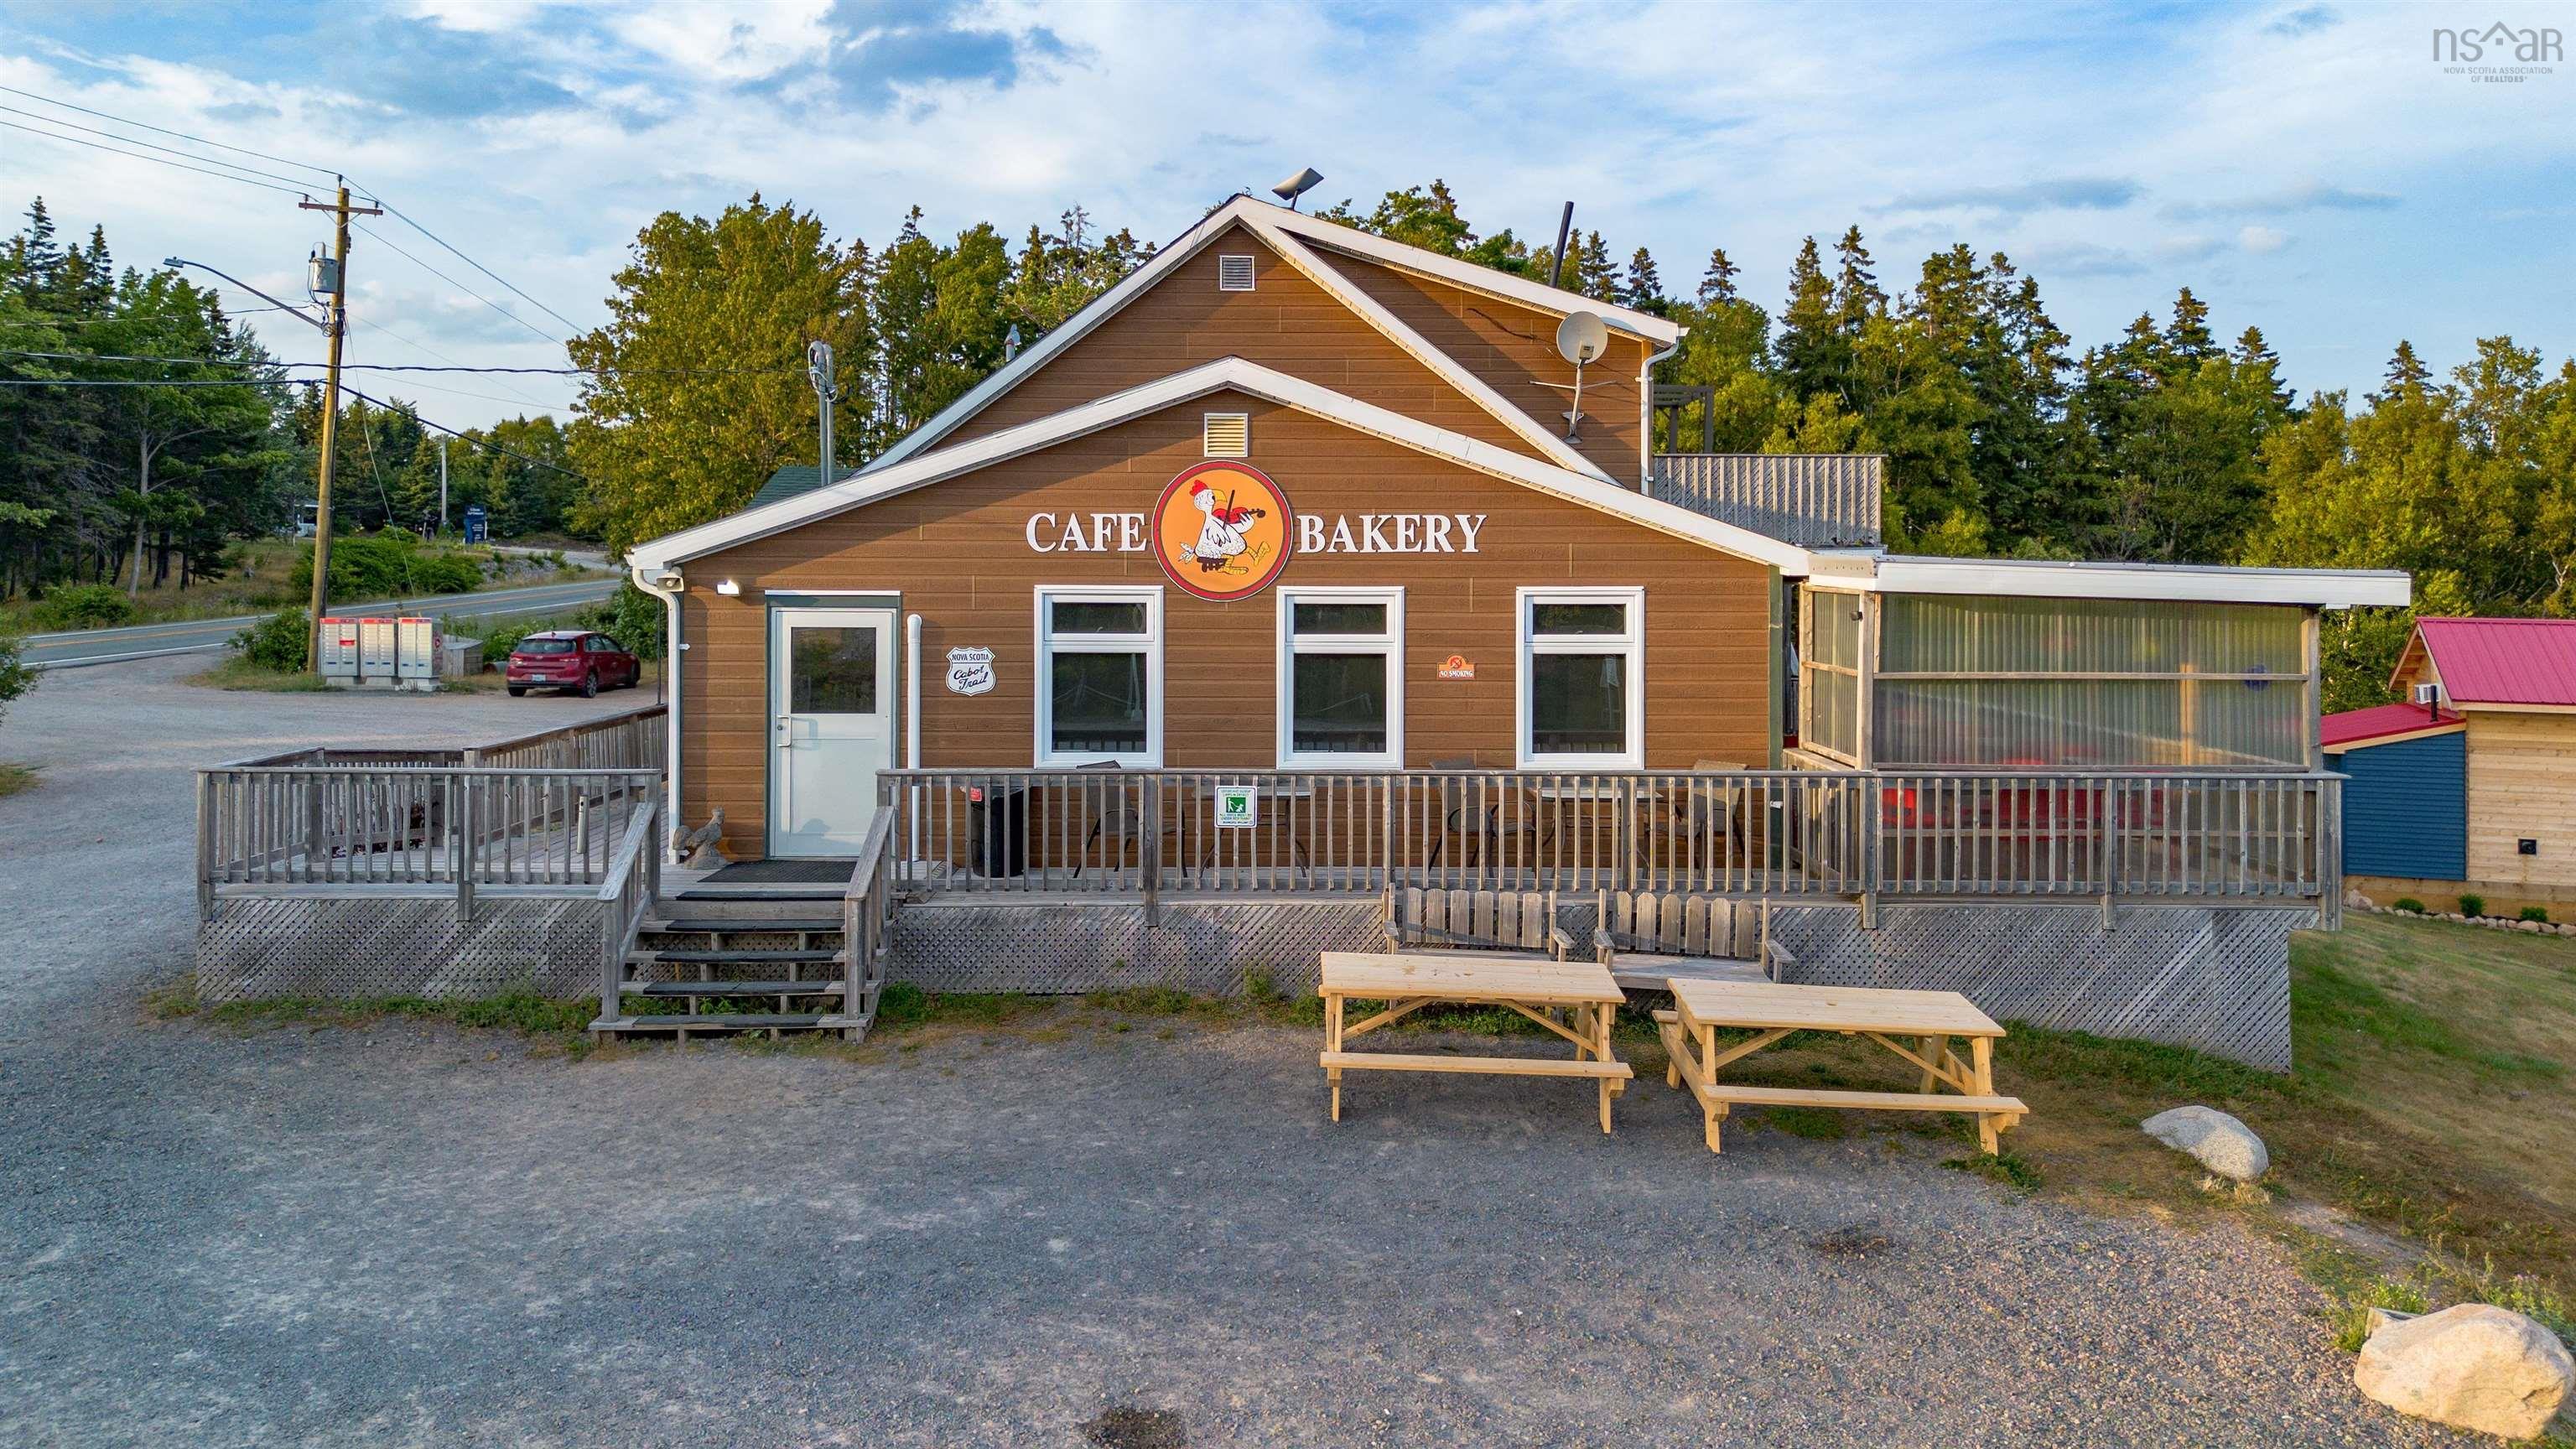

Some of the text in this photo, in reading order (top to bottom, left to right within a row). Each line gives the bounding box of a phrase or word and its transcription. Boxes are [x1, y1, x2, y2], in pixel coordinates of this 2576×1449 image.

[1026, 512, 1488, 553] CAFE BAKERY
[953, 665, 984, 680] Cabot
[958, 672, 989, 690] Trail
